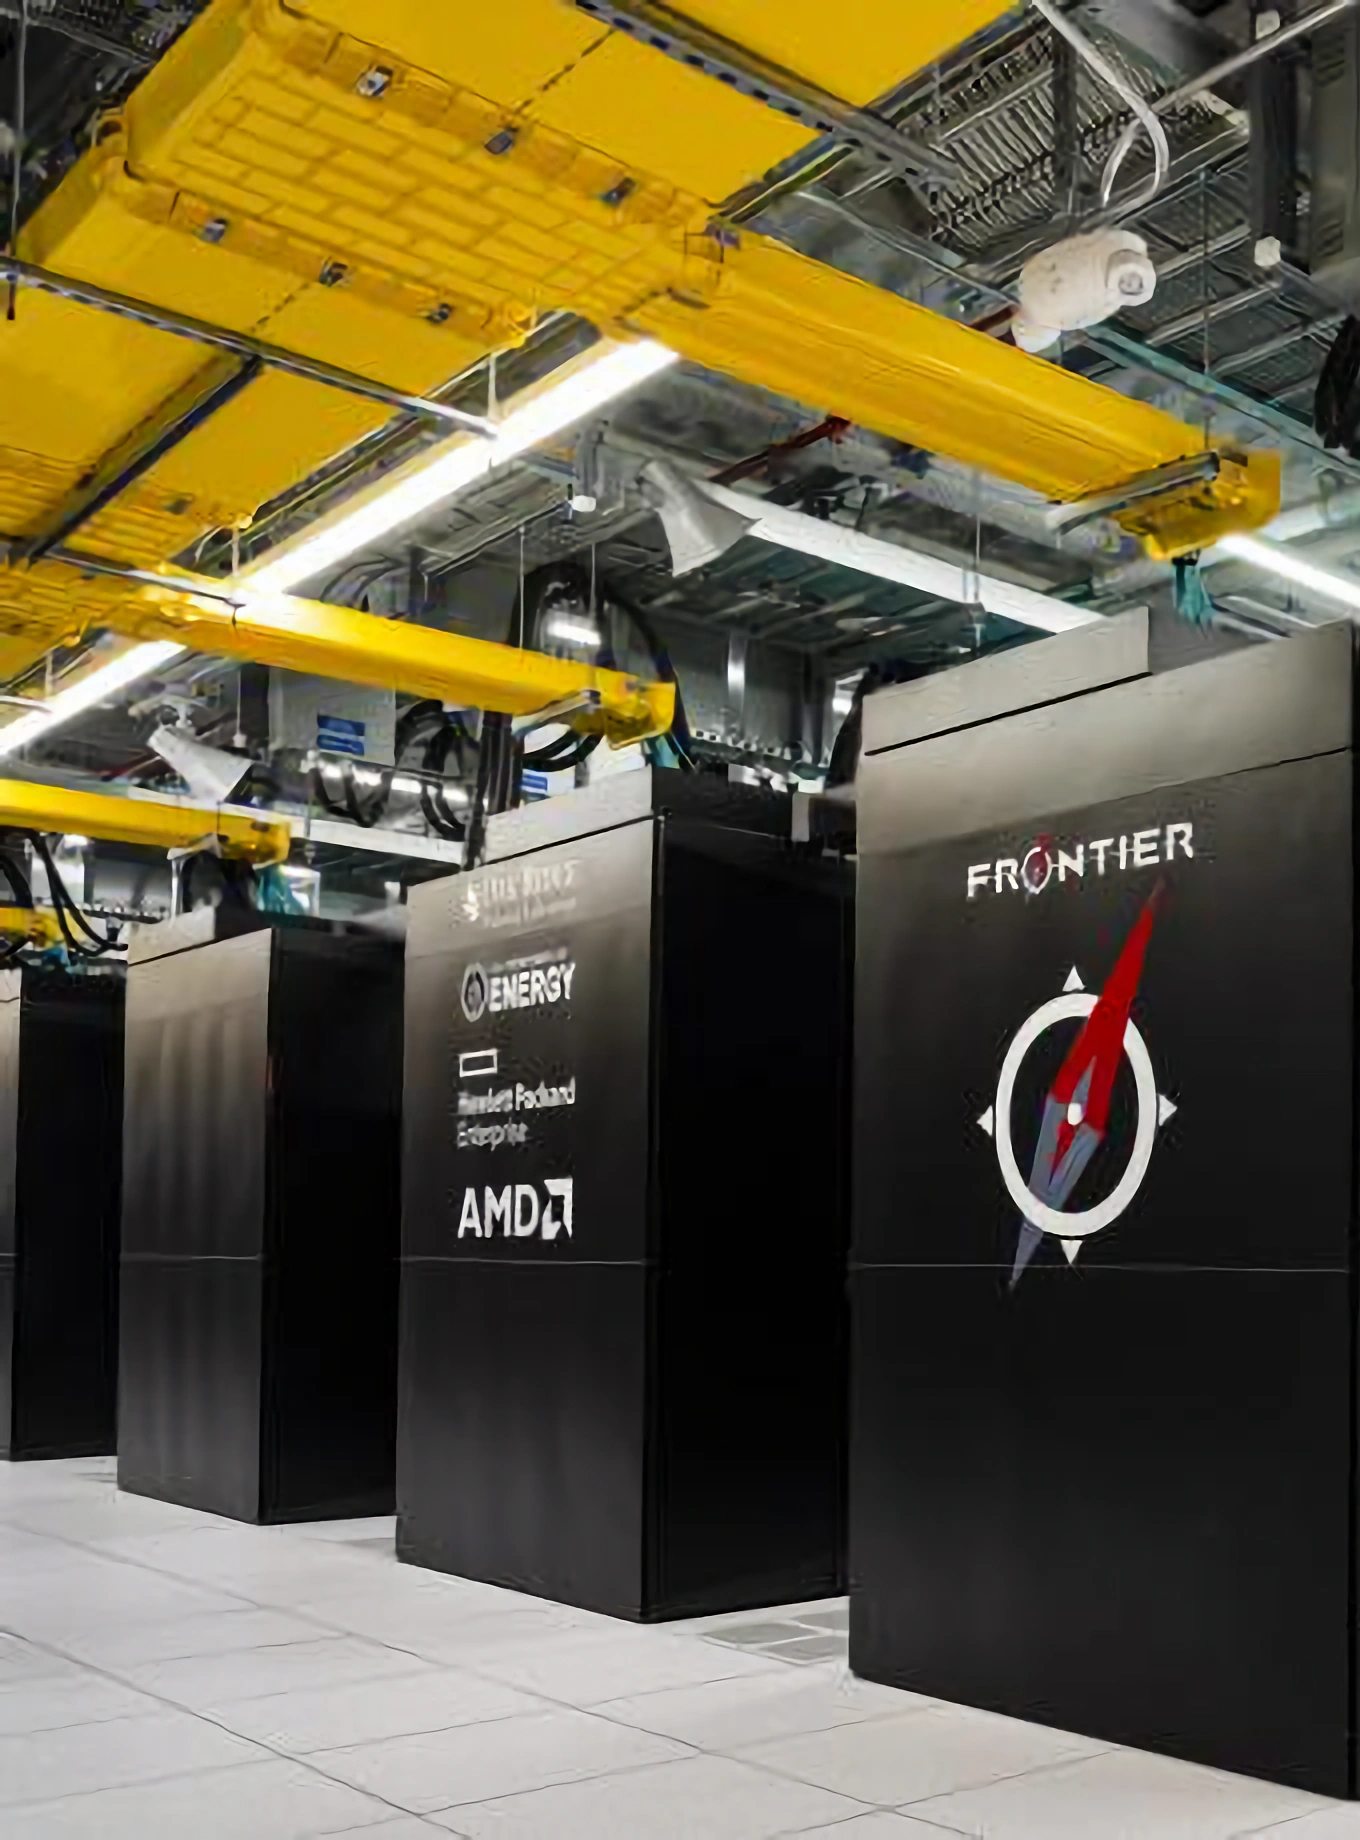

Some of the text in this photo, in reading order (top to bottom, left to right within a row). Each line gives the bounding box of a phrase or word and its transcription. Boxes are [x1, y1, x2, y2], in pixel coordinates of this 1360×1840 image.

[966, 822, 1194, 897] FRONTIER
[488, 962, 576, 1012] ENERGY
[457, 1184, 539, 1239] AMD
